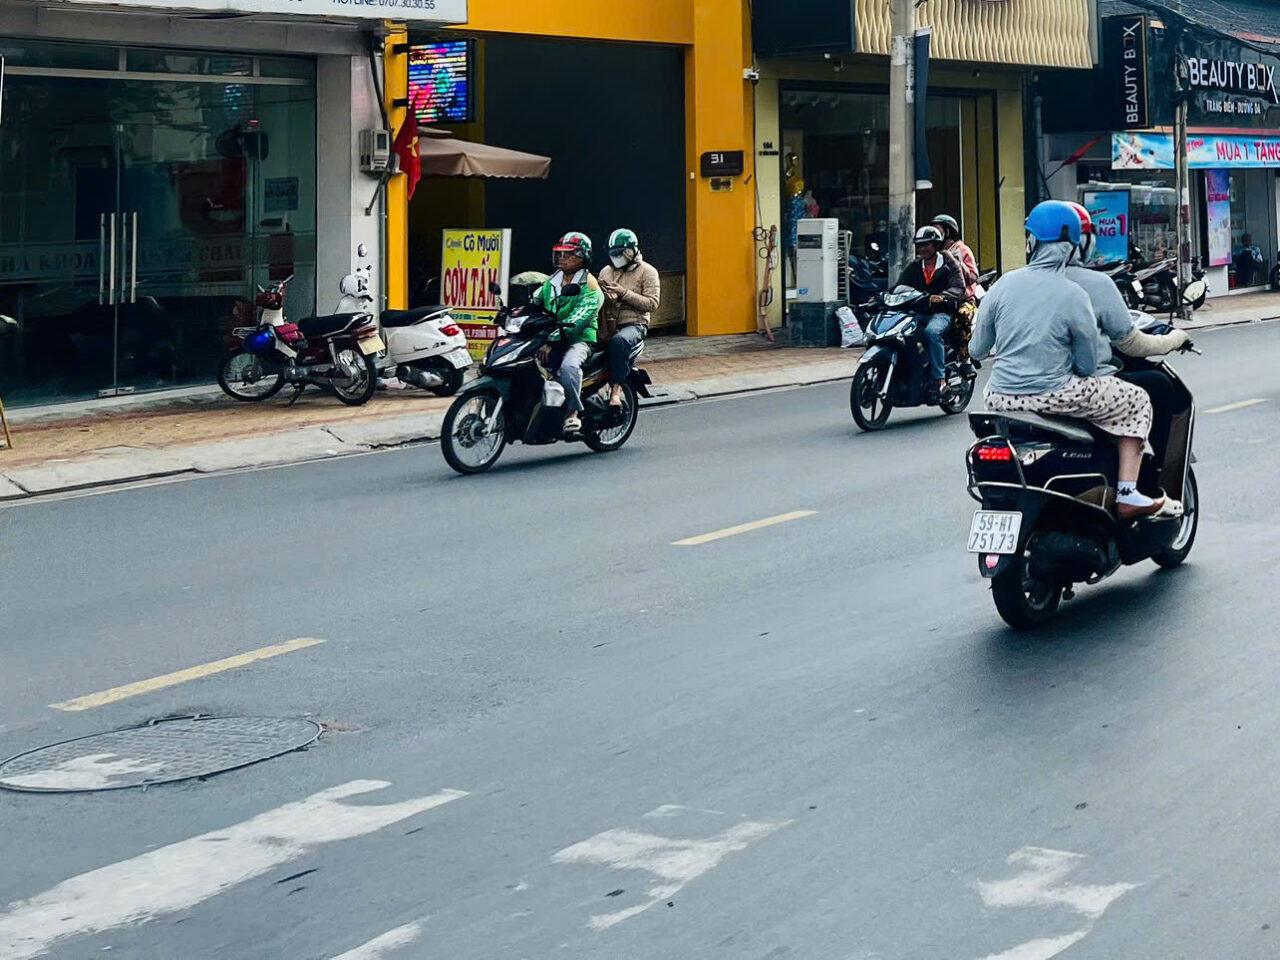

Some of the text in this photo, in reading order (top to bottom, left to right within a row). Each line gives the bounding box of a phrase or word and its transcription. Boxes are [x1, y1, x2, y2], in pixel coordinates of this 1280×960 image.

[1188, 57, 1244, 89] BEAUTY
[1124, 65, 1138, 123] BEAUTY
[1216, 141, 1241, 160] MUA
[463, 234, 475, 252] Cô
[477, 234, 499, 252] Mười
[444, 253, 498, 307] CƠM TẤM
[968, 533, 1015, 551] 751.73
